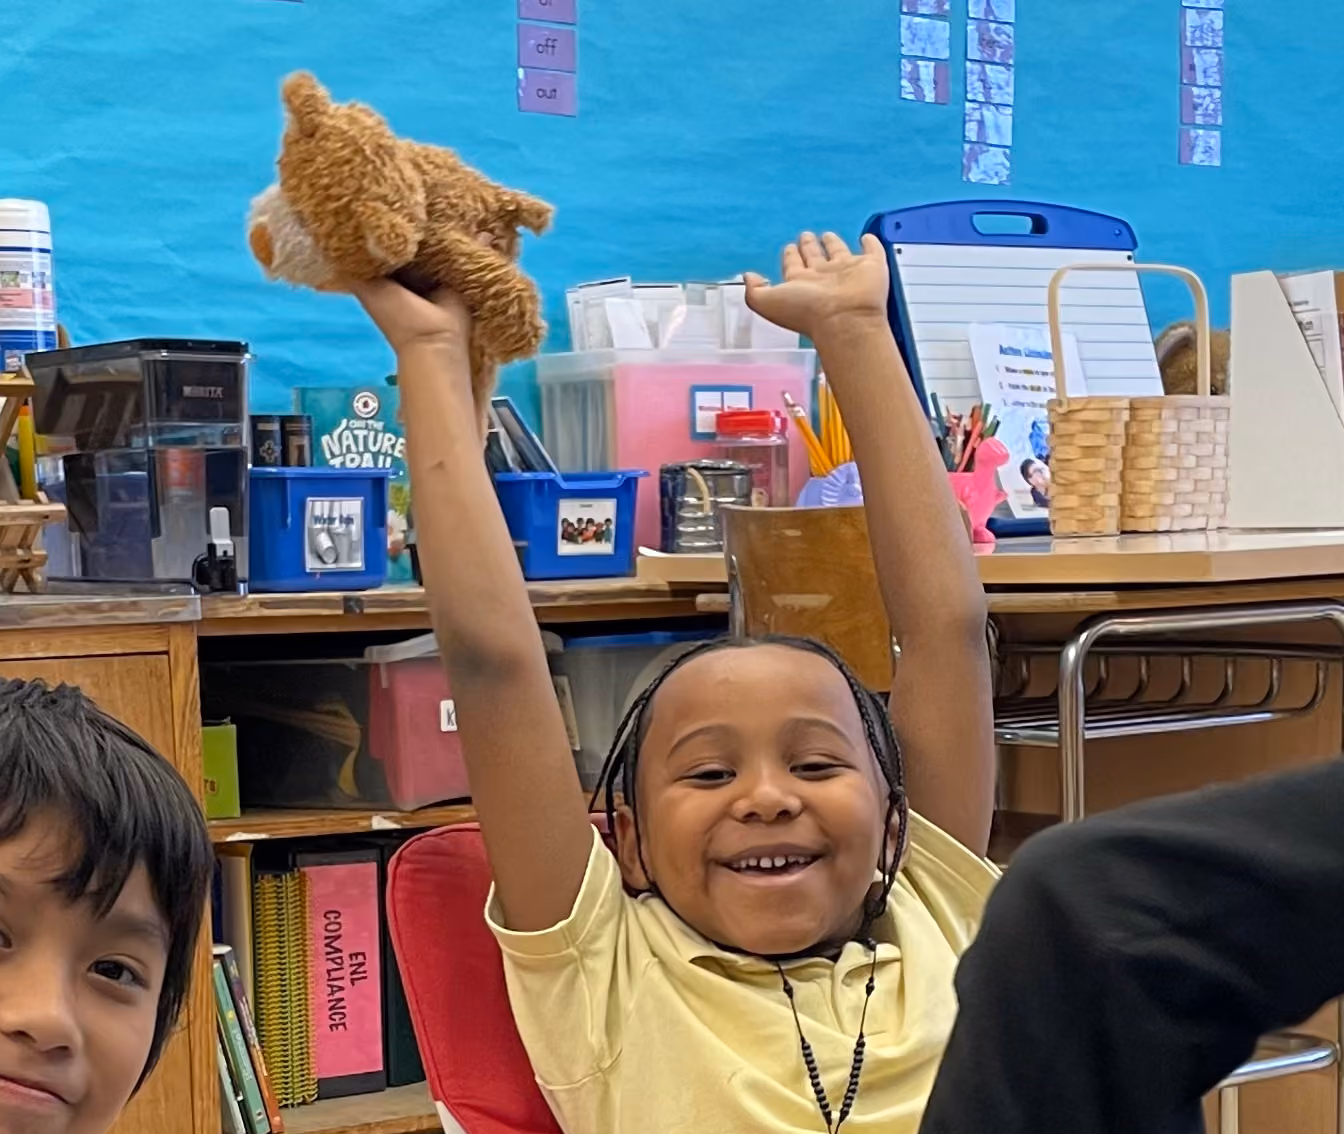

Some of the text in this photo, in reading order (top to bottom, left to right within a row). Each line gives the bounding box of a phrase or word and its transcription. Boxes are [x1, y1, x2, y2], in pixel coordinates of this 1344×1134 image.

[536, 37, 558, 56] off
[536, 87, 558, 100] out
[321, 419, 406, 460] NATURE
[323, 909, 347, 1032] COMPLIANCE
[348, 951, 368, 987] ENL
